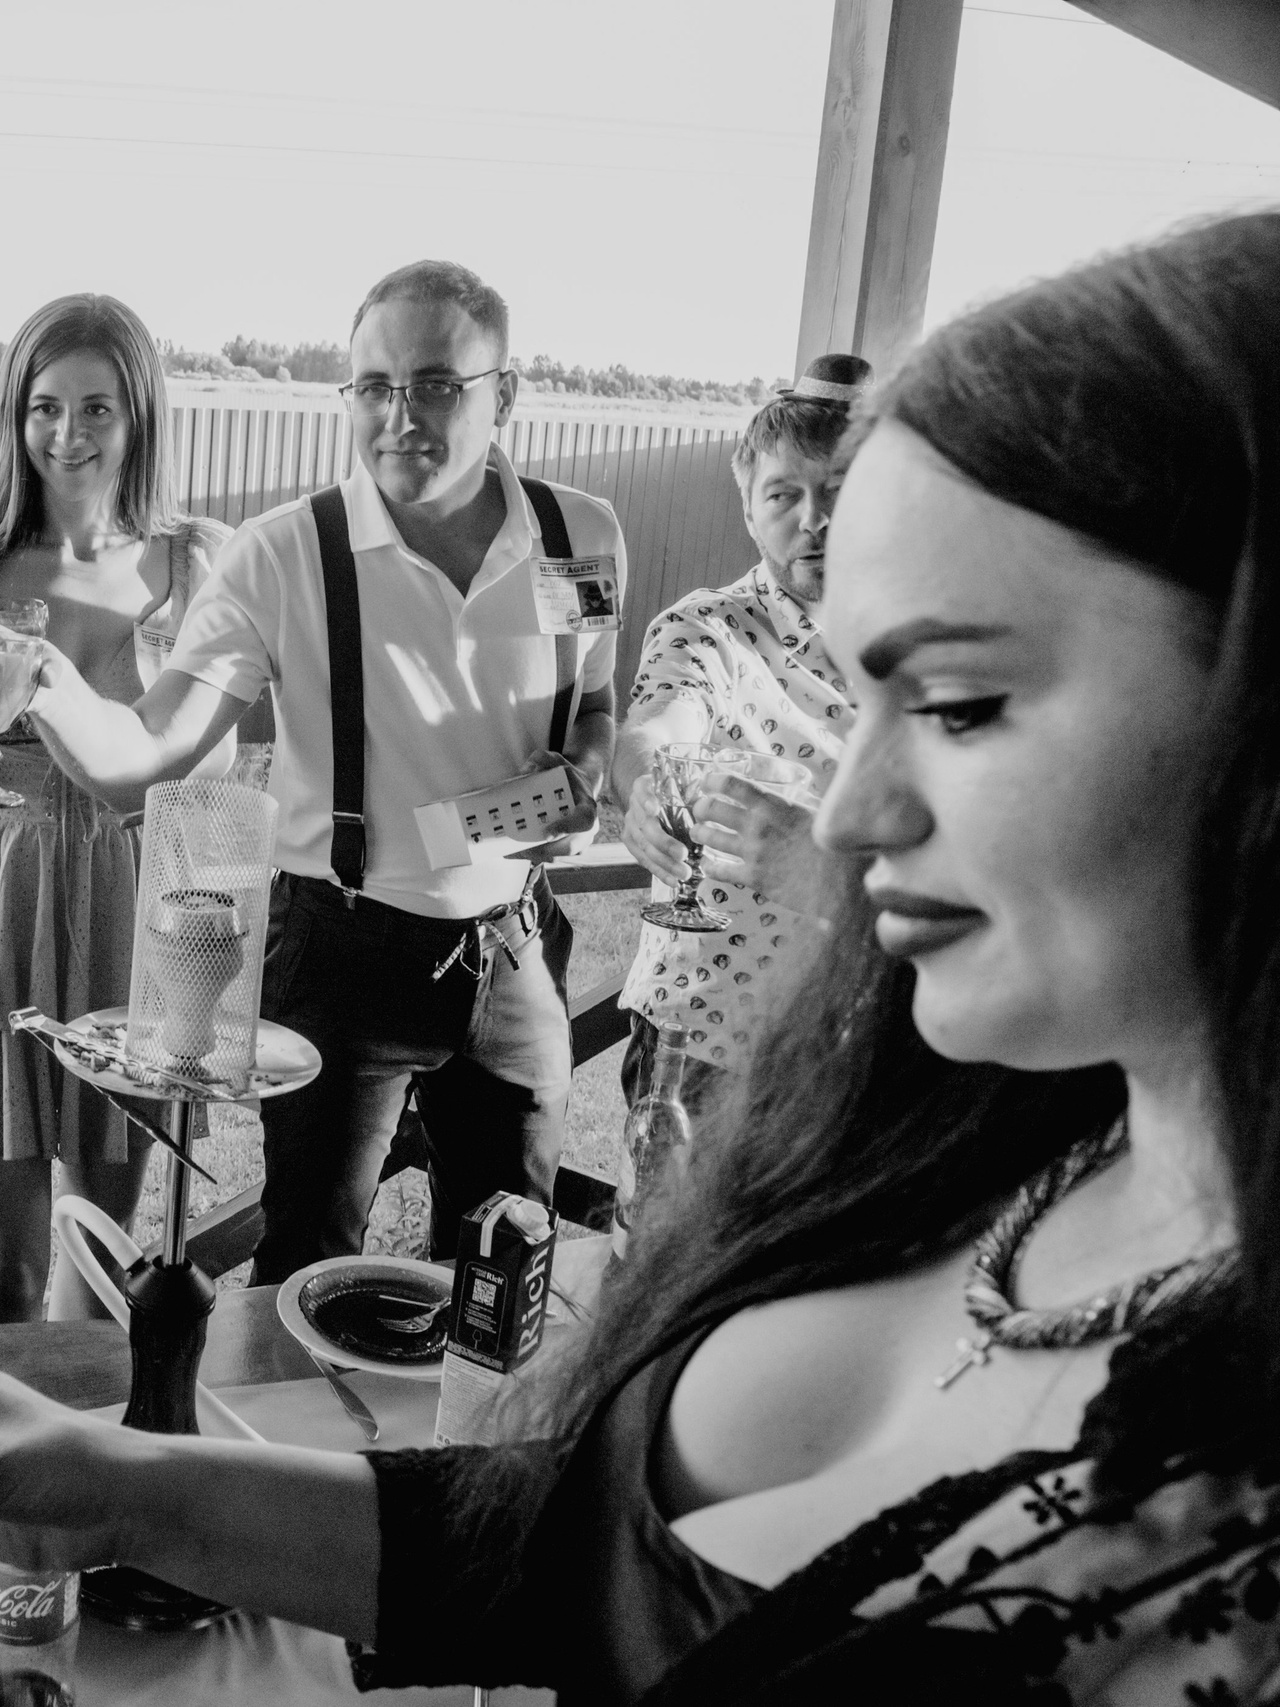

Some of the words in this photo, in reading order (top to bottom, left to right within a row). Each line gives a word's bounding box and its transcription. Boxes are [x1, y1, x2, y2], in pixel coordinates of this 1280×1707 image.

[540, 565, 565, 574] SECRET
[567, 563, 600, 574] AGENT
[141, 633, 163, 644] SECRET
[486, 1272, 504, 1285] Rich
[516, 1246, 550, 1359] Rich
